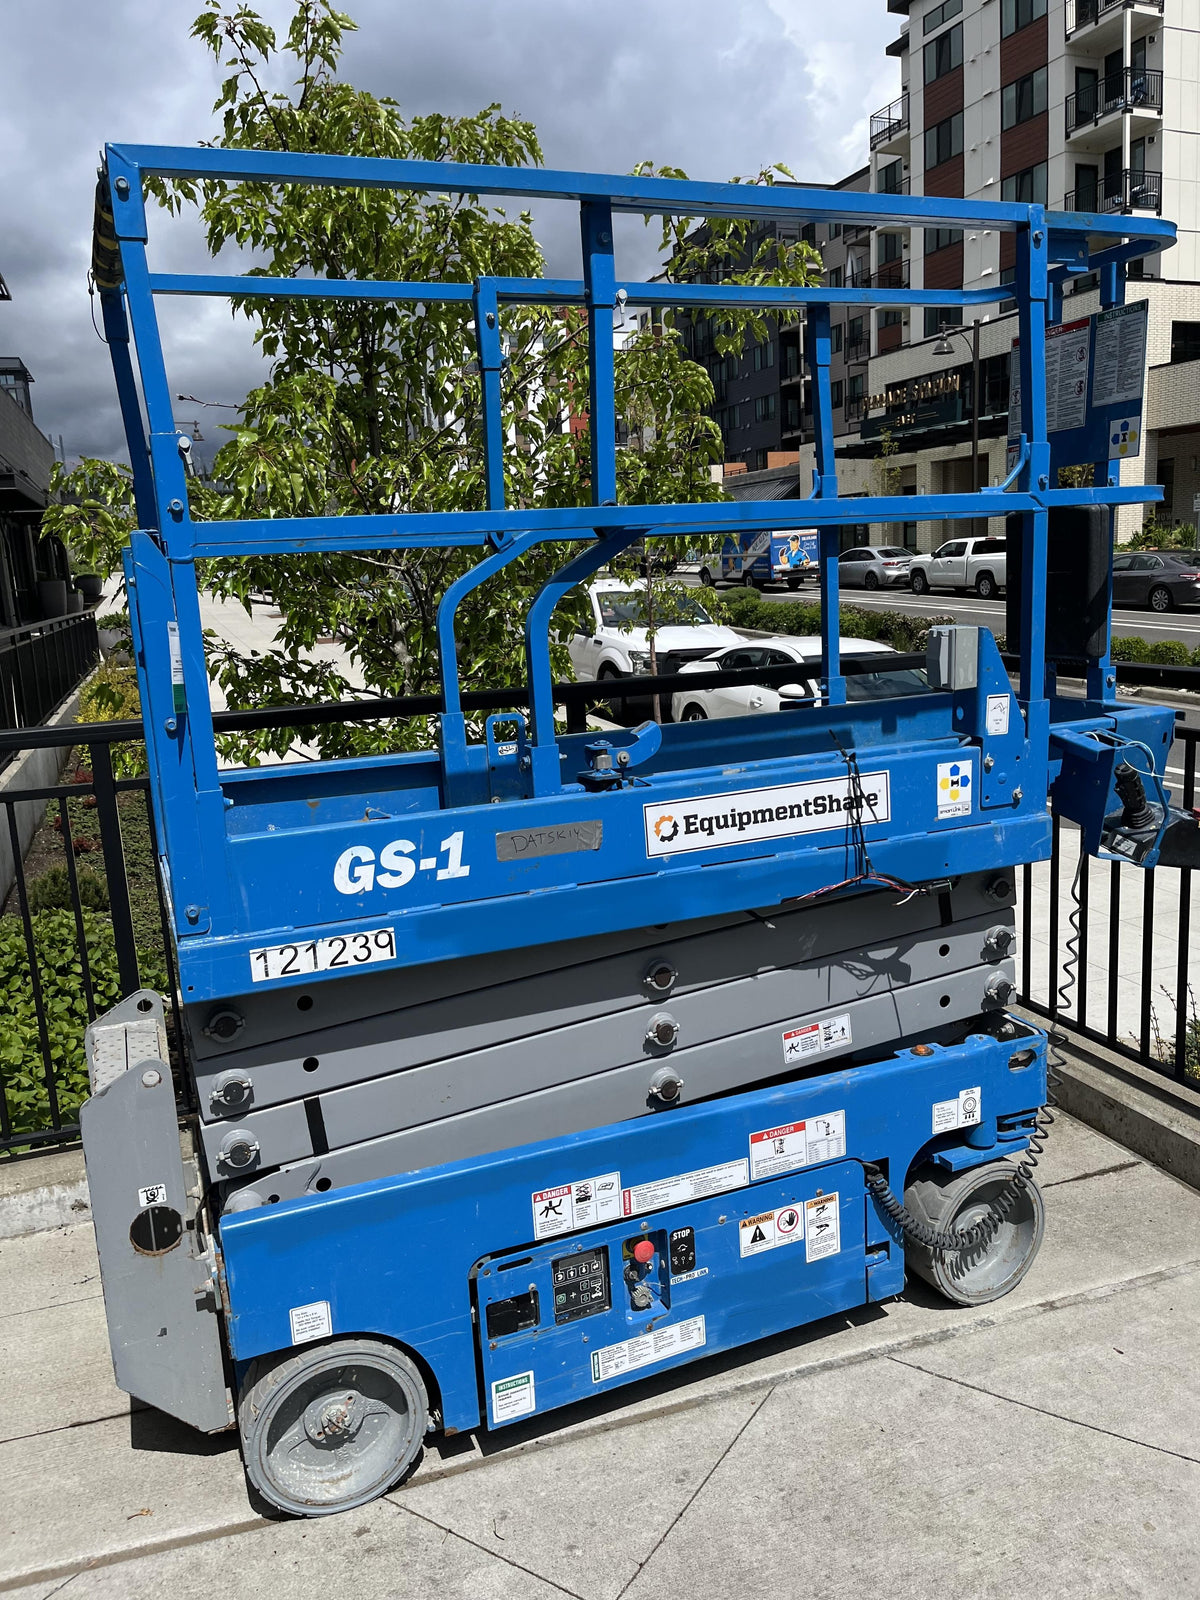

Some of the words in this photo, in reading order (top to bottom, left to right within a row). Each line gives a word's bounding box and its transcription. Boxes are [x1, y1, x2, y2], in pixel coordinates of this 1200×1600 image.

[684, 792, 879, 836] EquipmentShare
[333, 831, 471, 895] GS-1
[256, 929, 395, 978] 121239
[795, 1026, 812, 1036] DANGER
[769, 1125, 795, 1138] DANGER
[542, 1187, 569, 1200] DANGER
[813, 1196, 834, 1206] WARNING
[748, 1213, 773, 1226] WARNING
[673, 1229, 690, 1241] STOP
[498, 1376, 528, 1391] INSTRUCTIONS
